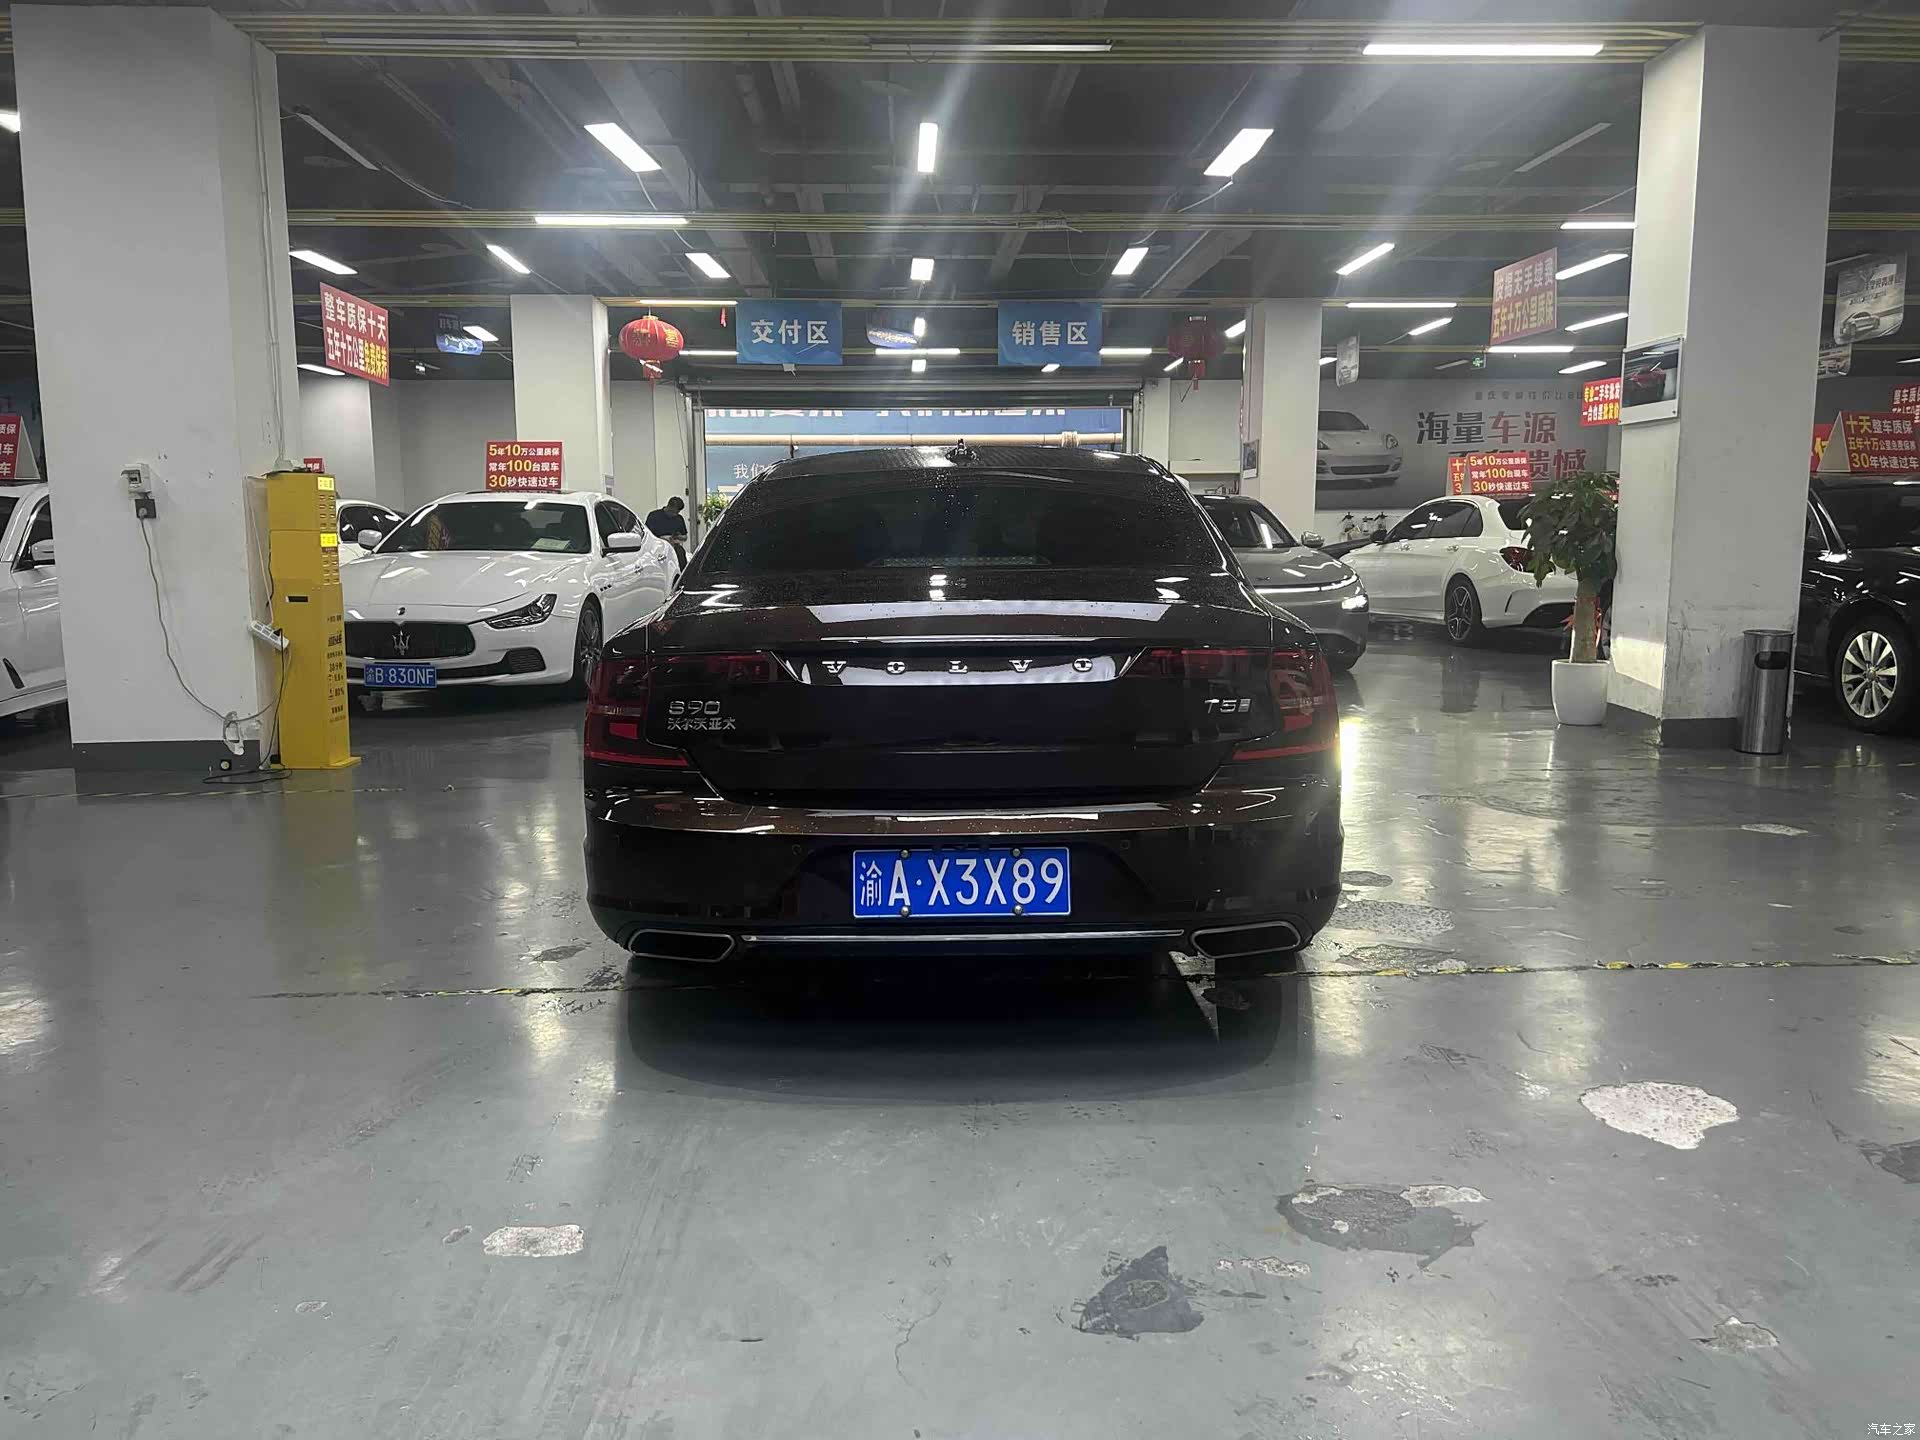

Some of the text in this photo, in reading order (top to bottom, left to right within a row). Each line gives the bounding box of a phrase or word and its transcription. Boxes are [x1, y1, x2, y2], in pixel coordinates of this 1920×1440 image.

[324, 292, 386, 342] 整车质保十天
[1492, 291, 1553, 338] 五年十万公里质保
[751, 320, 829, 345] 交付区
[1012, 320, 1089, 346] 销售区
[1416, 411, 1558, 445] 海量车源
[1846, 415, 1912, 434] 十天整车质保
[489, 444, 560, 456] 5年10万公里质保
[488, 460, 560, 472] 常年100台现车
[1470, 456, 1527, 466] 5年10万公里质保
[1471, 468, 1529, 478] 常年100台现车
[489, 475, 559, 488] 30秒快速过车
[1473, 481, 1530, 492] 30秒快速过车
[821, 658, 1093, 674] VOLVO
[669, 701, 720, 714] S90
[667, 717, 736, 730] 沃尔沃亚太
